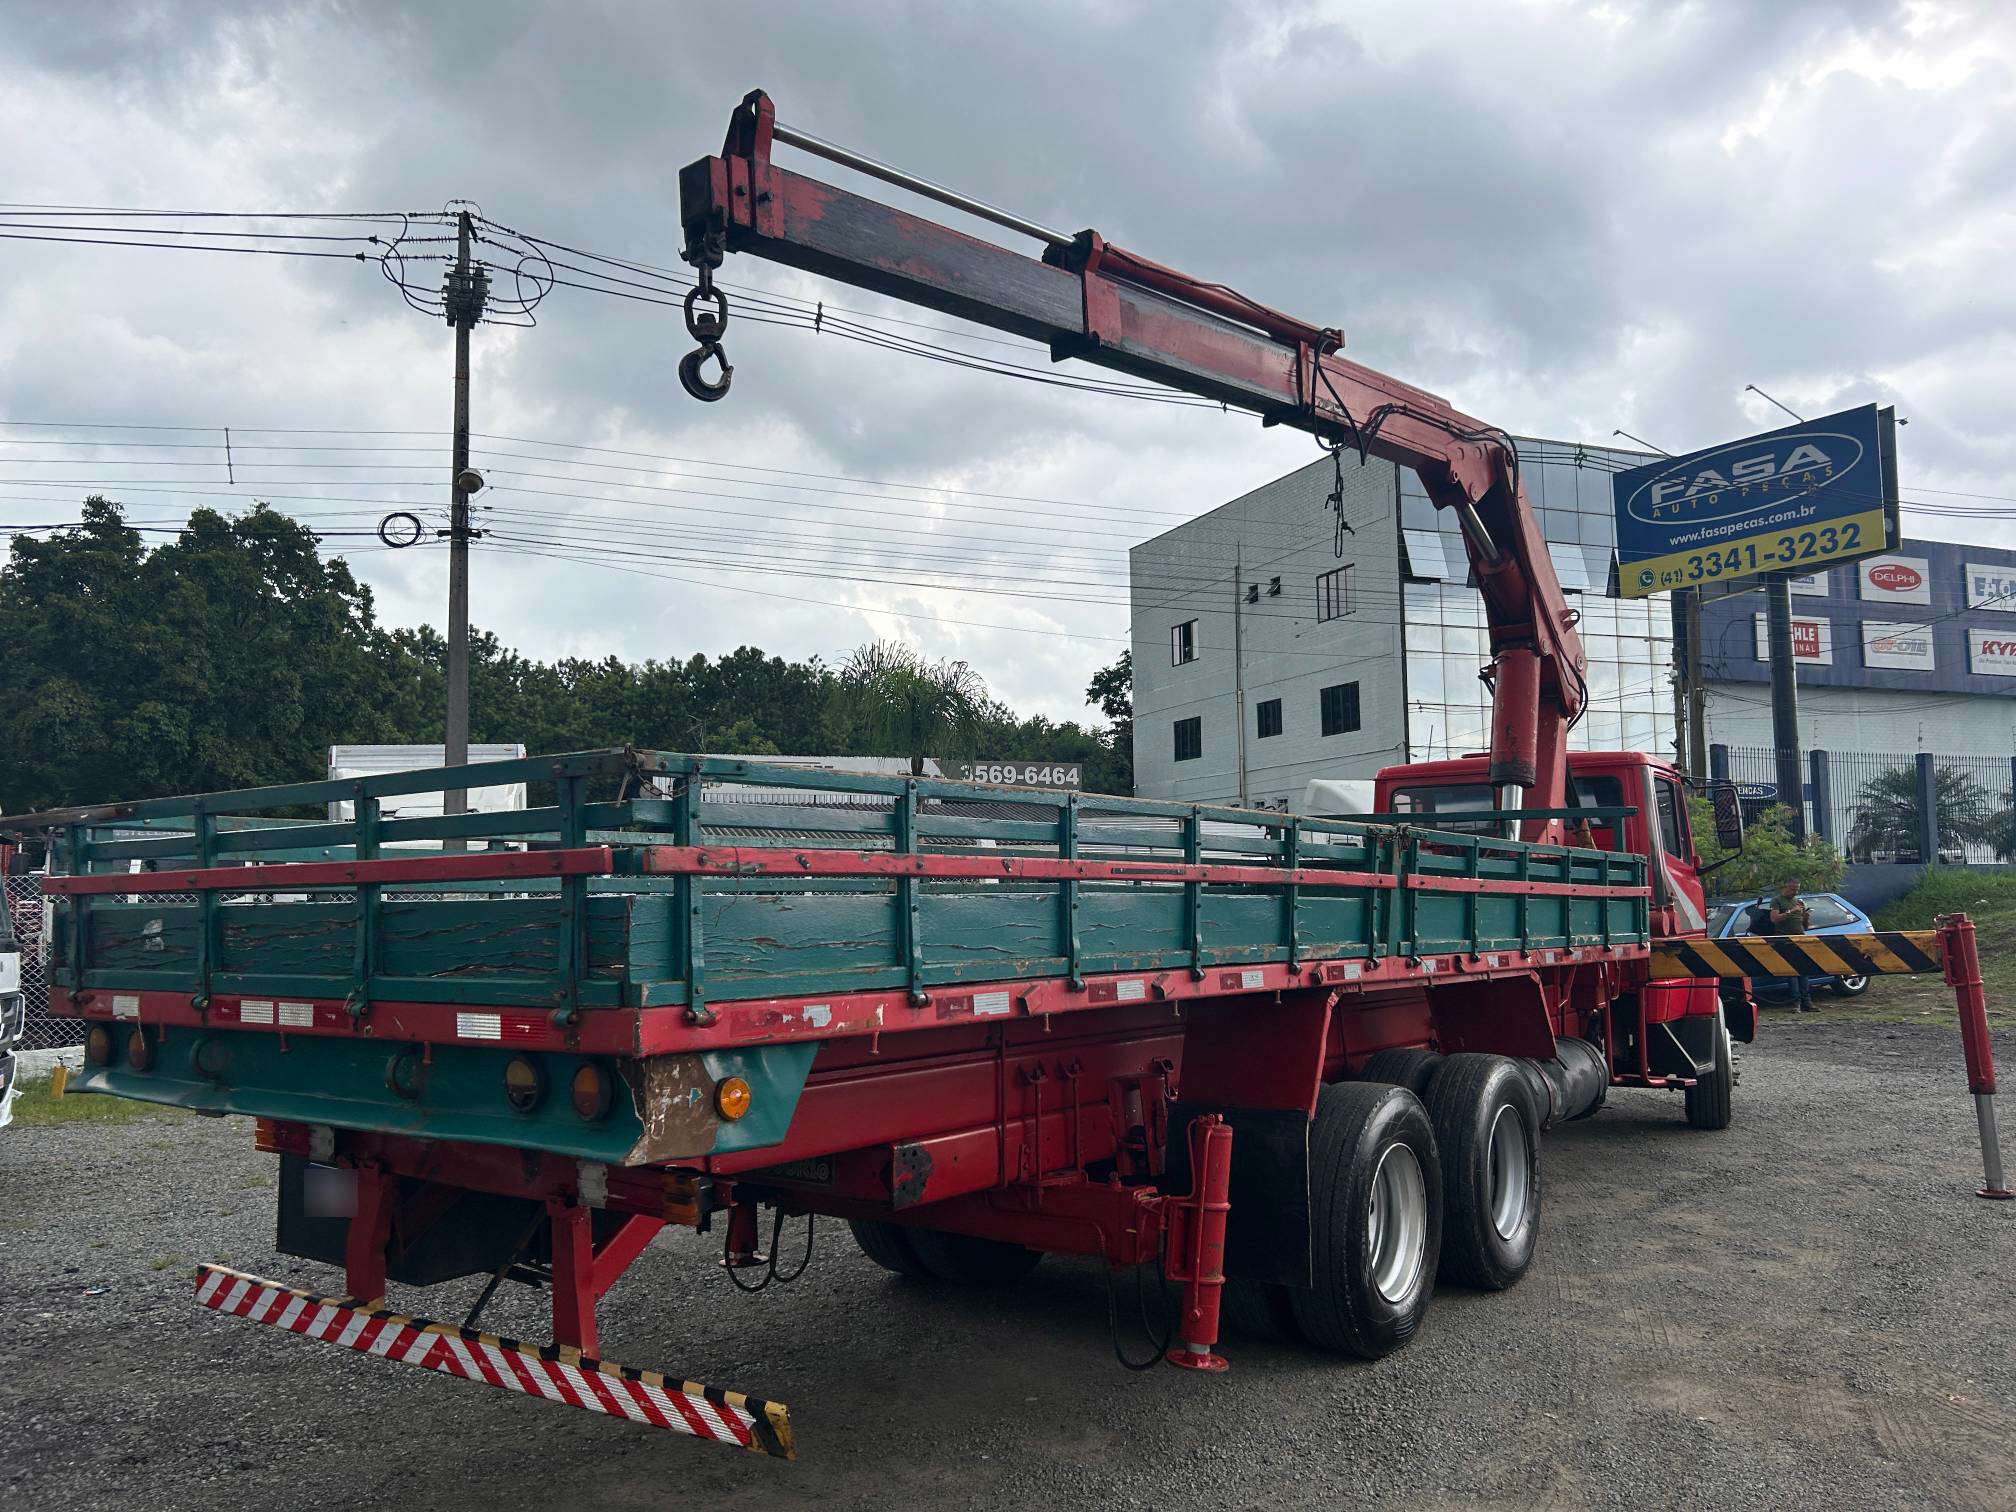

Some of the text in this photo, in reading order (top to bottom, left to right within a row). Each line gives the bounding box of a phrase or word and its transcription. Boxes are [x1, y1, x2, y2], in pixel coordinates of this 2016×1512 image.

[1651, 443, 1832, 504] FASA
[1652, 494, 1719, 518] AUTO
[1669, 504, 1817, 546] www.fasapecas.com.br
[1660, 522, 1862, 586] (41) 3341-3232
[1874, 572, 1916, 584] DELPHI
[1793, 626, 1815, 641] HLE
[1737, 786, 1764, 796] ENDAS
